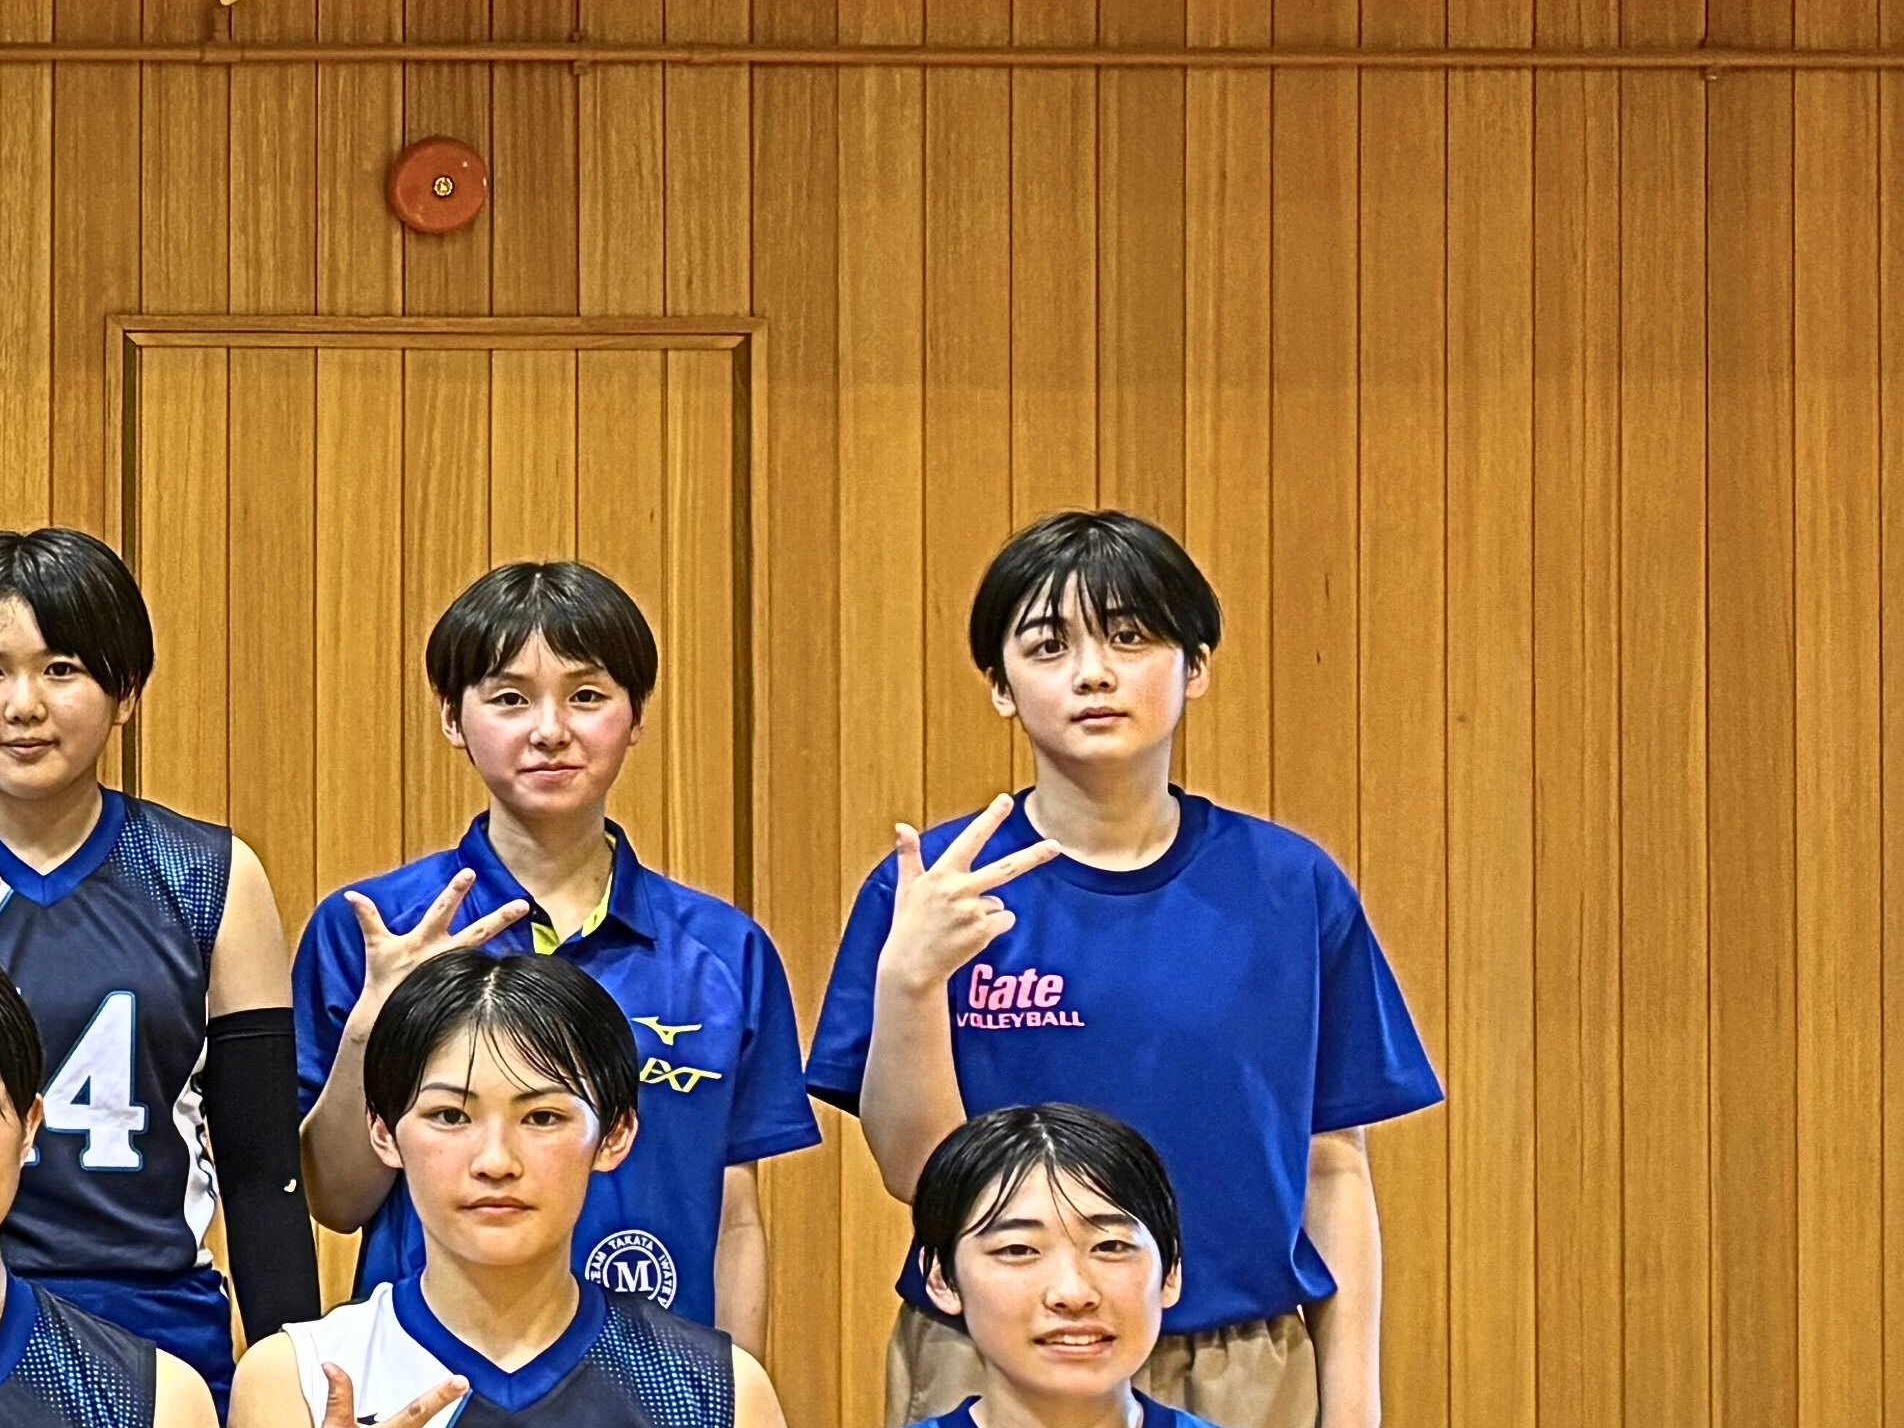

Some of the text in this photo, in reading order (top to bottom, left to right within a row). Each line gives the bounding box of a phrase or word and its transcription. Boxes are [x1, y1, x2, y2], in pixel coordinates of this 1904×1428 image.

[969, 963, 1064, 1010] Gate
[956, 1010, 1085, 1029] VOLLEYBALL
[590, 1251, 607, 1283] EAM
[608, 1235, 653, 1251] TAKATA
[612, 1260, 654, 1293] M
